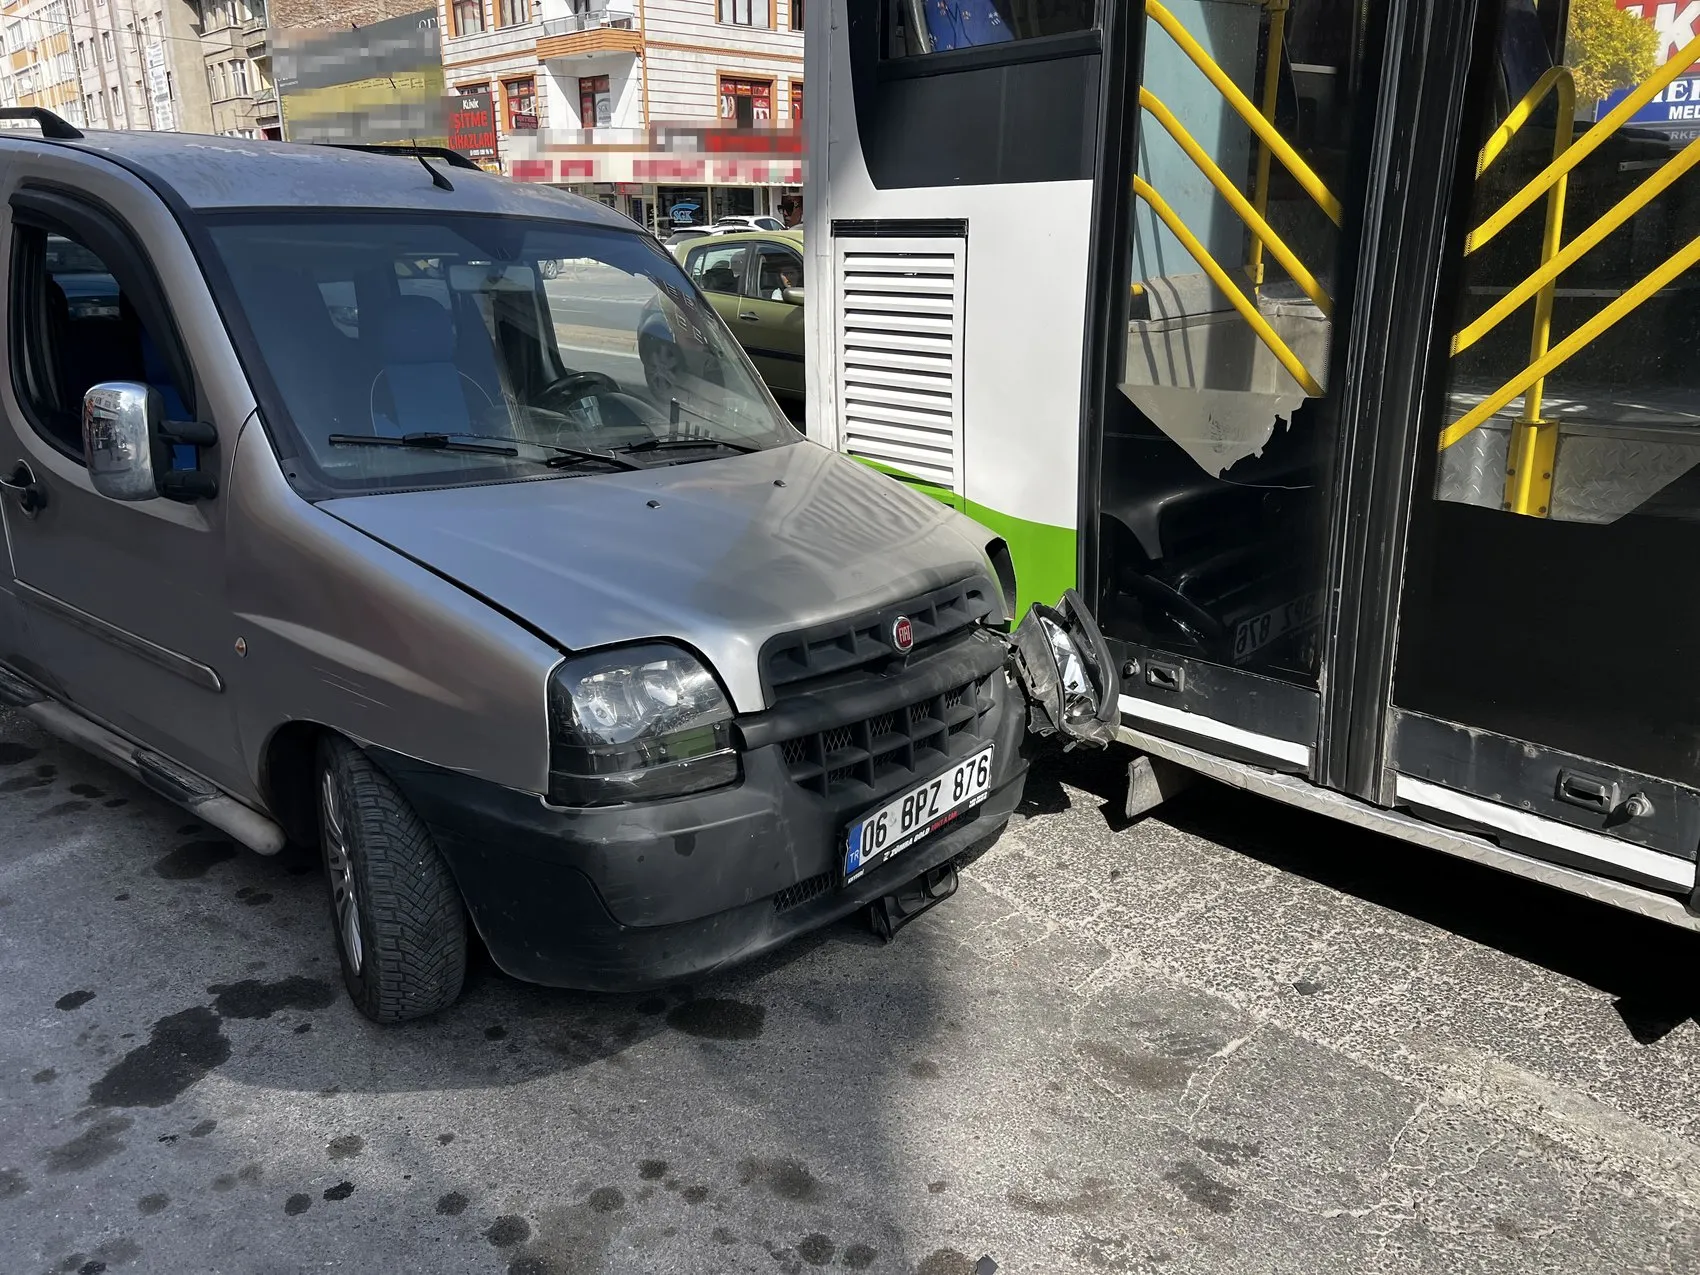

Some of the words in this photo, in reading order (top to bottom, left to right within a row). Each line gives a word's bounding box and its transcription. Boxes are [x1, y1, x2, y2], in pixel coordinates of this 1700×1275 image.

[673, 210, 692, 220] SGK
[898, 625, 911, 643] FIAT
[862, 811, 888, 857] 06
[901, 780, 942, 833] BPZ
[952, 754, 989, 802] 876
[849, 849, 860, 863] TR
